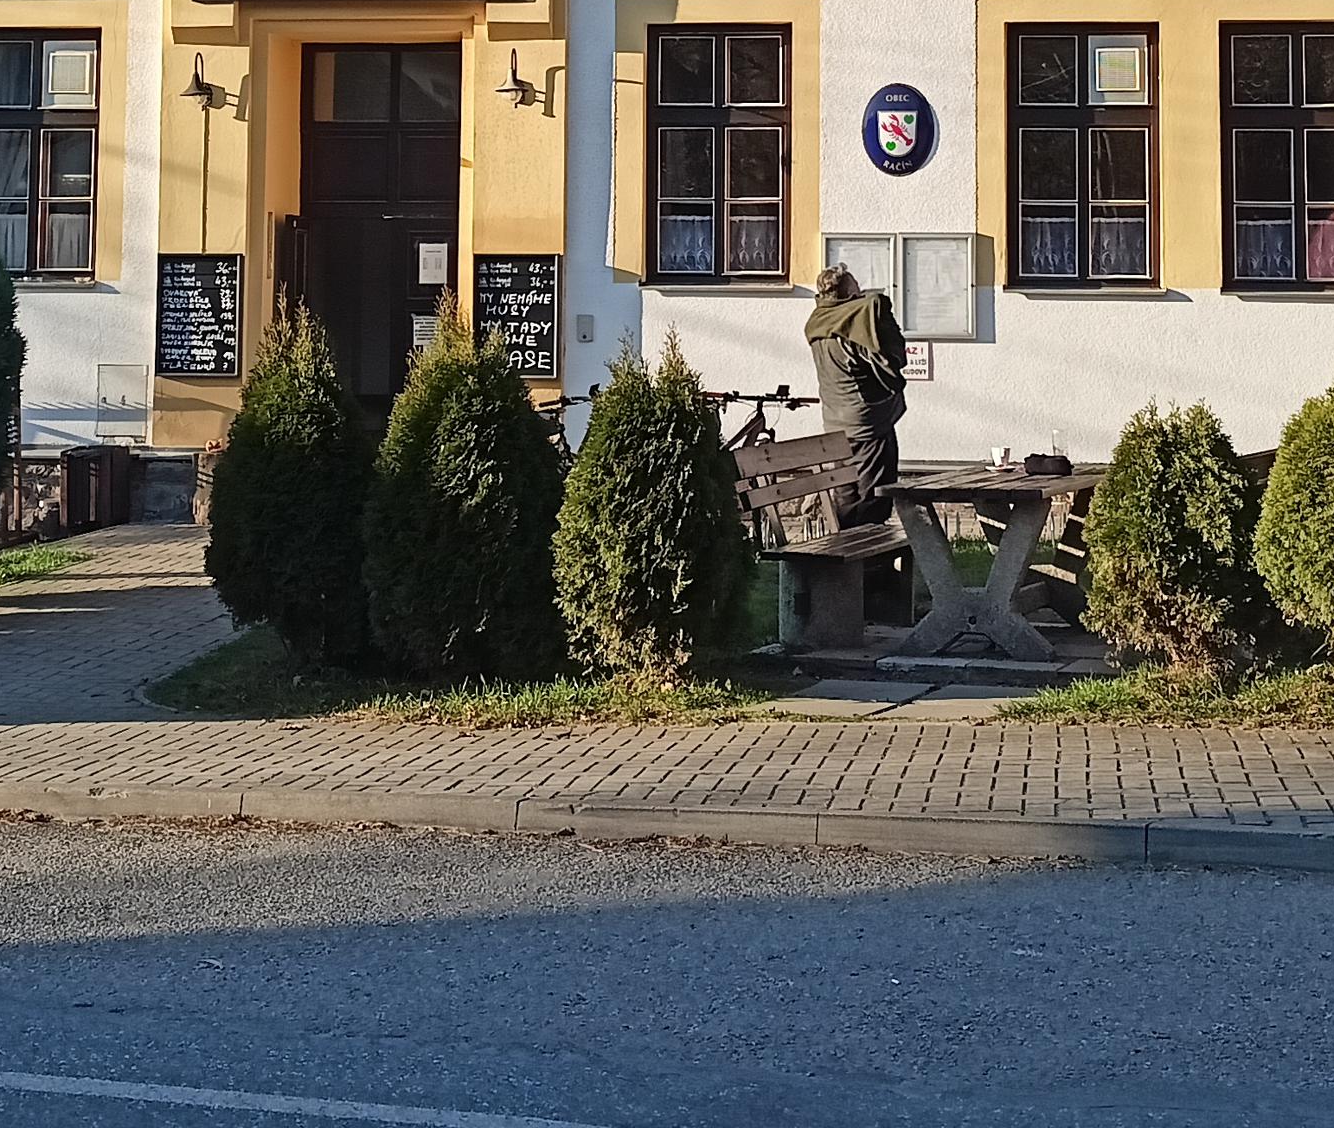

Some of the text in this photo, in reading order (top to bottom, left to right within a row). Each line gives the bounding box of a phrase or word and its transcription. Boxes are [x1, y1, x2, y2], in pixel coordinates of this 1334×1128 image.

[885, 94, 910, 102] OBEC
[506, 321, 552, 335] TADY
[507, 350, 551, 369] ASE
